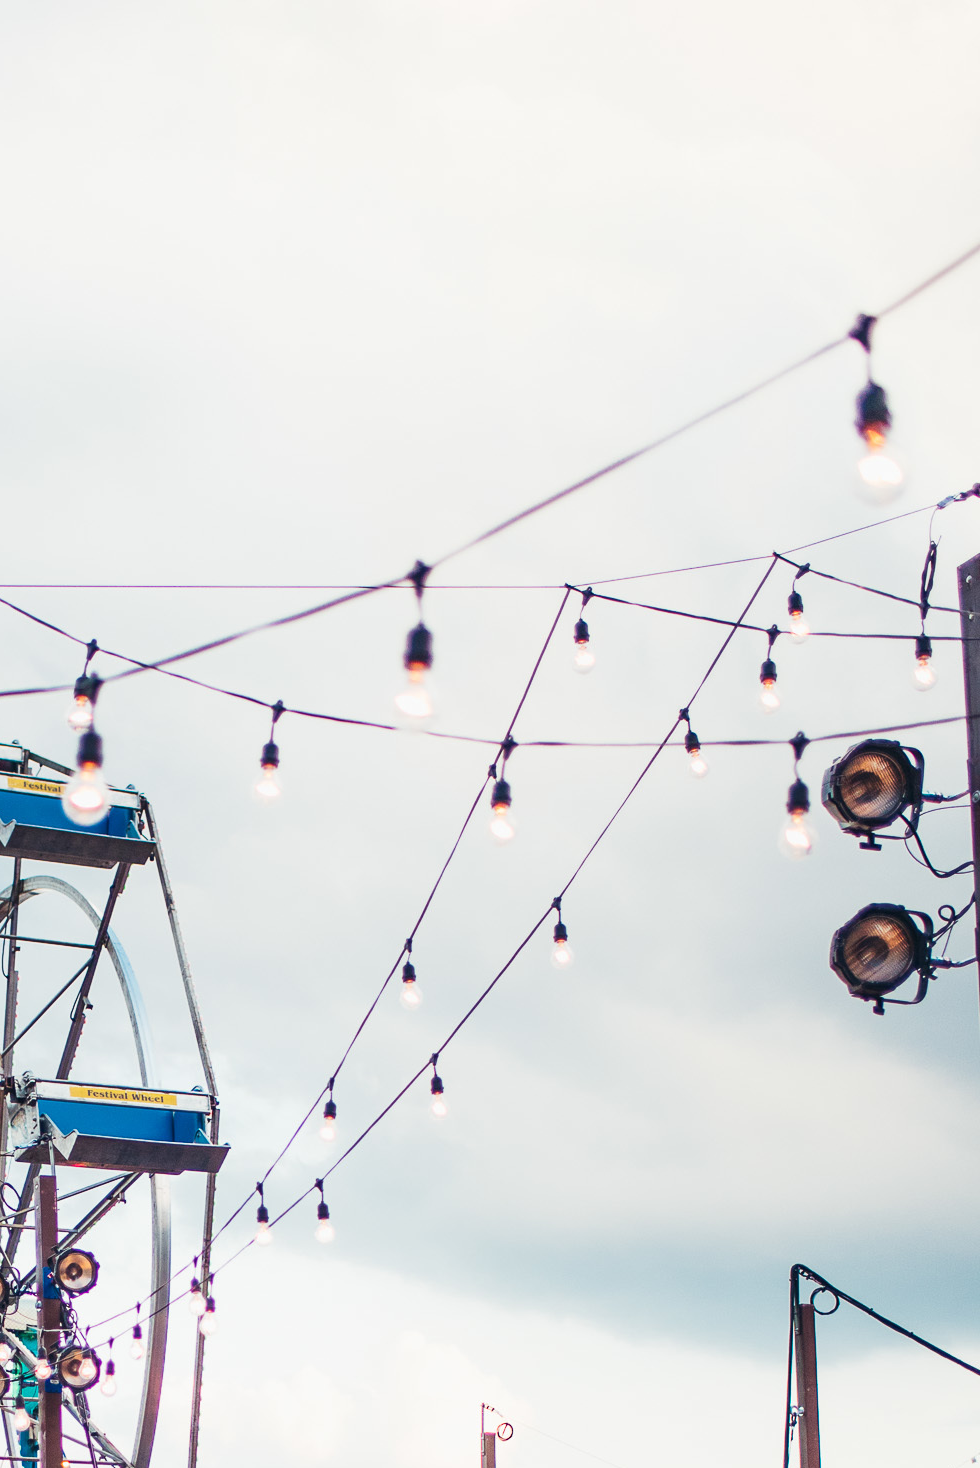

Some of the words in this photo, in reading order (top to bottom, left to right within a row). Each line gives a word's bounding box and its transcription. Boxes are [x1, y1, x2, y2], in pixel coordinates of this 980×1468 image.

[23, 781, 61, 793] Festival
[87, 1089, 128, 1100] Festival
[131, 1093, 164, 1103] Wheel
